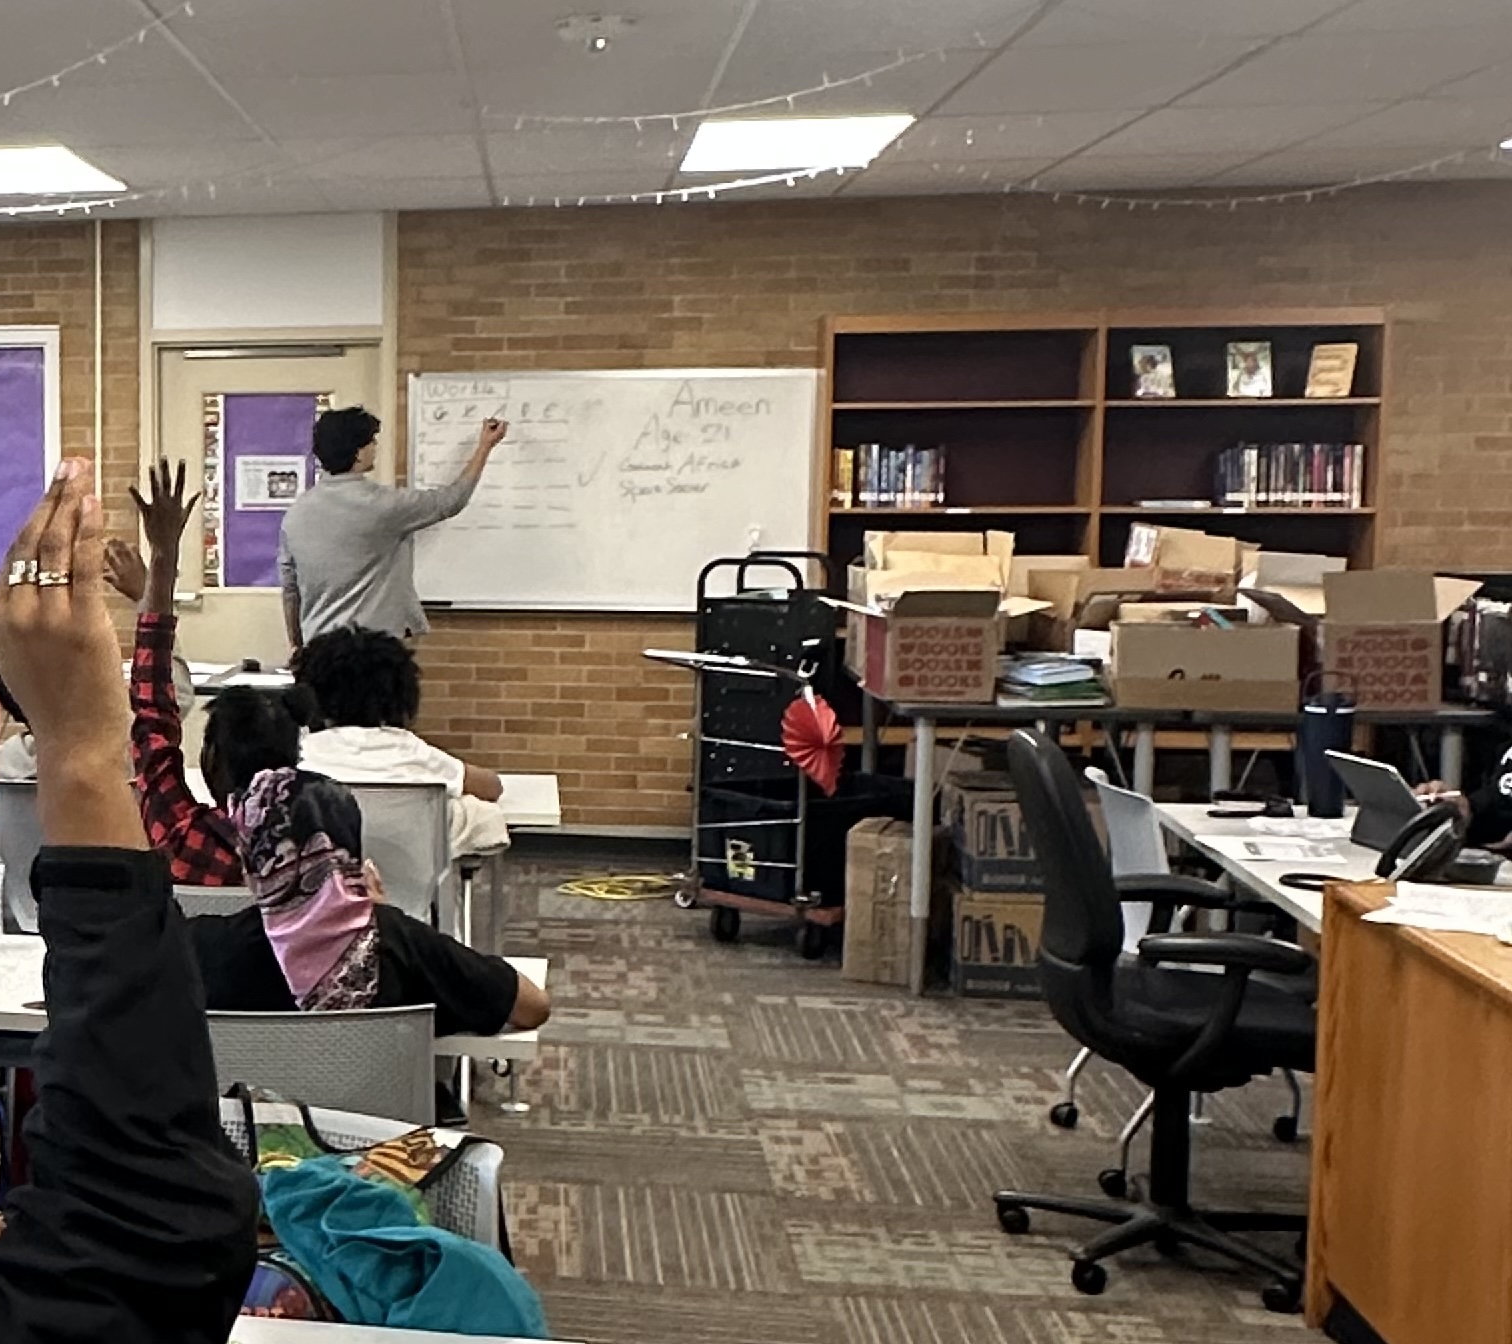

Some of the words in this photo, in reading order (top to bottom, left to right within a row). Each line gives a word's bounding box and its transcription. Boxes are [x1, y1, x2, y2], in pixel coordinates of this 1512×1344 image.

[667, 379, 771, 418] Ameen
[899, 626, 963, 639] BOOKS
[917, 642, 983, 655] BOOKS
[899, 658, 963, 671] BOOKS
[917, 674, 983, 688] BOOKS
